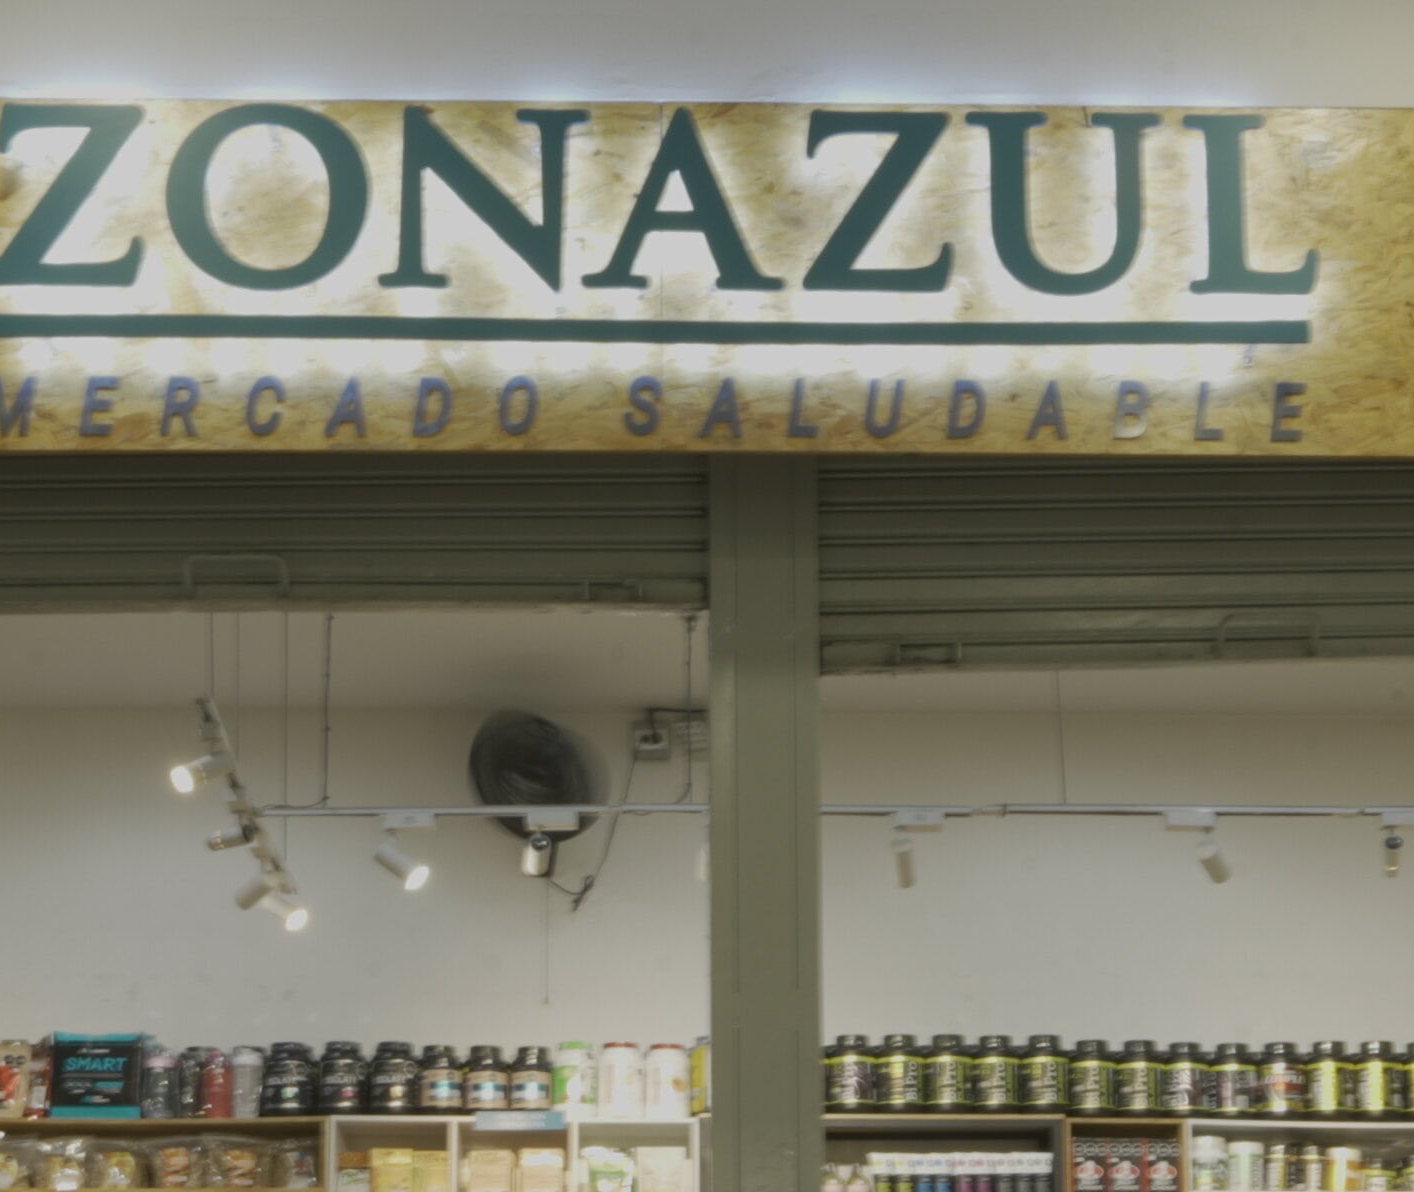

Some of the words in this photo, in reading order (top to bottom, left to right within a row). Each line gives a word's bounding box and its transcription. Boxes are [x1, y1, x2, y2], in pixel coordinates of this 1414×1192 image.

[622, 378, 1309, 444] SALUDABLE
[65, 1056, 127, 1072] SMART
[906, 1062, 918, 1085] Pro
